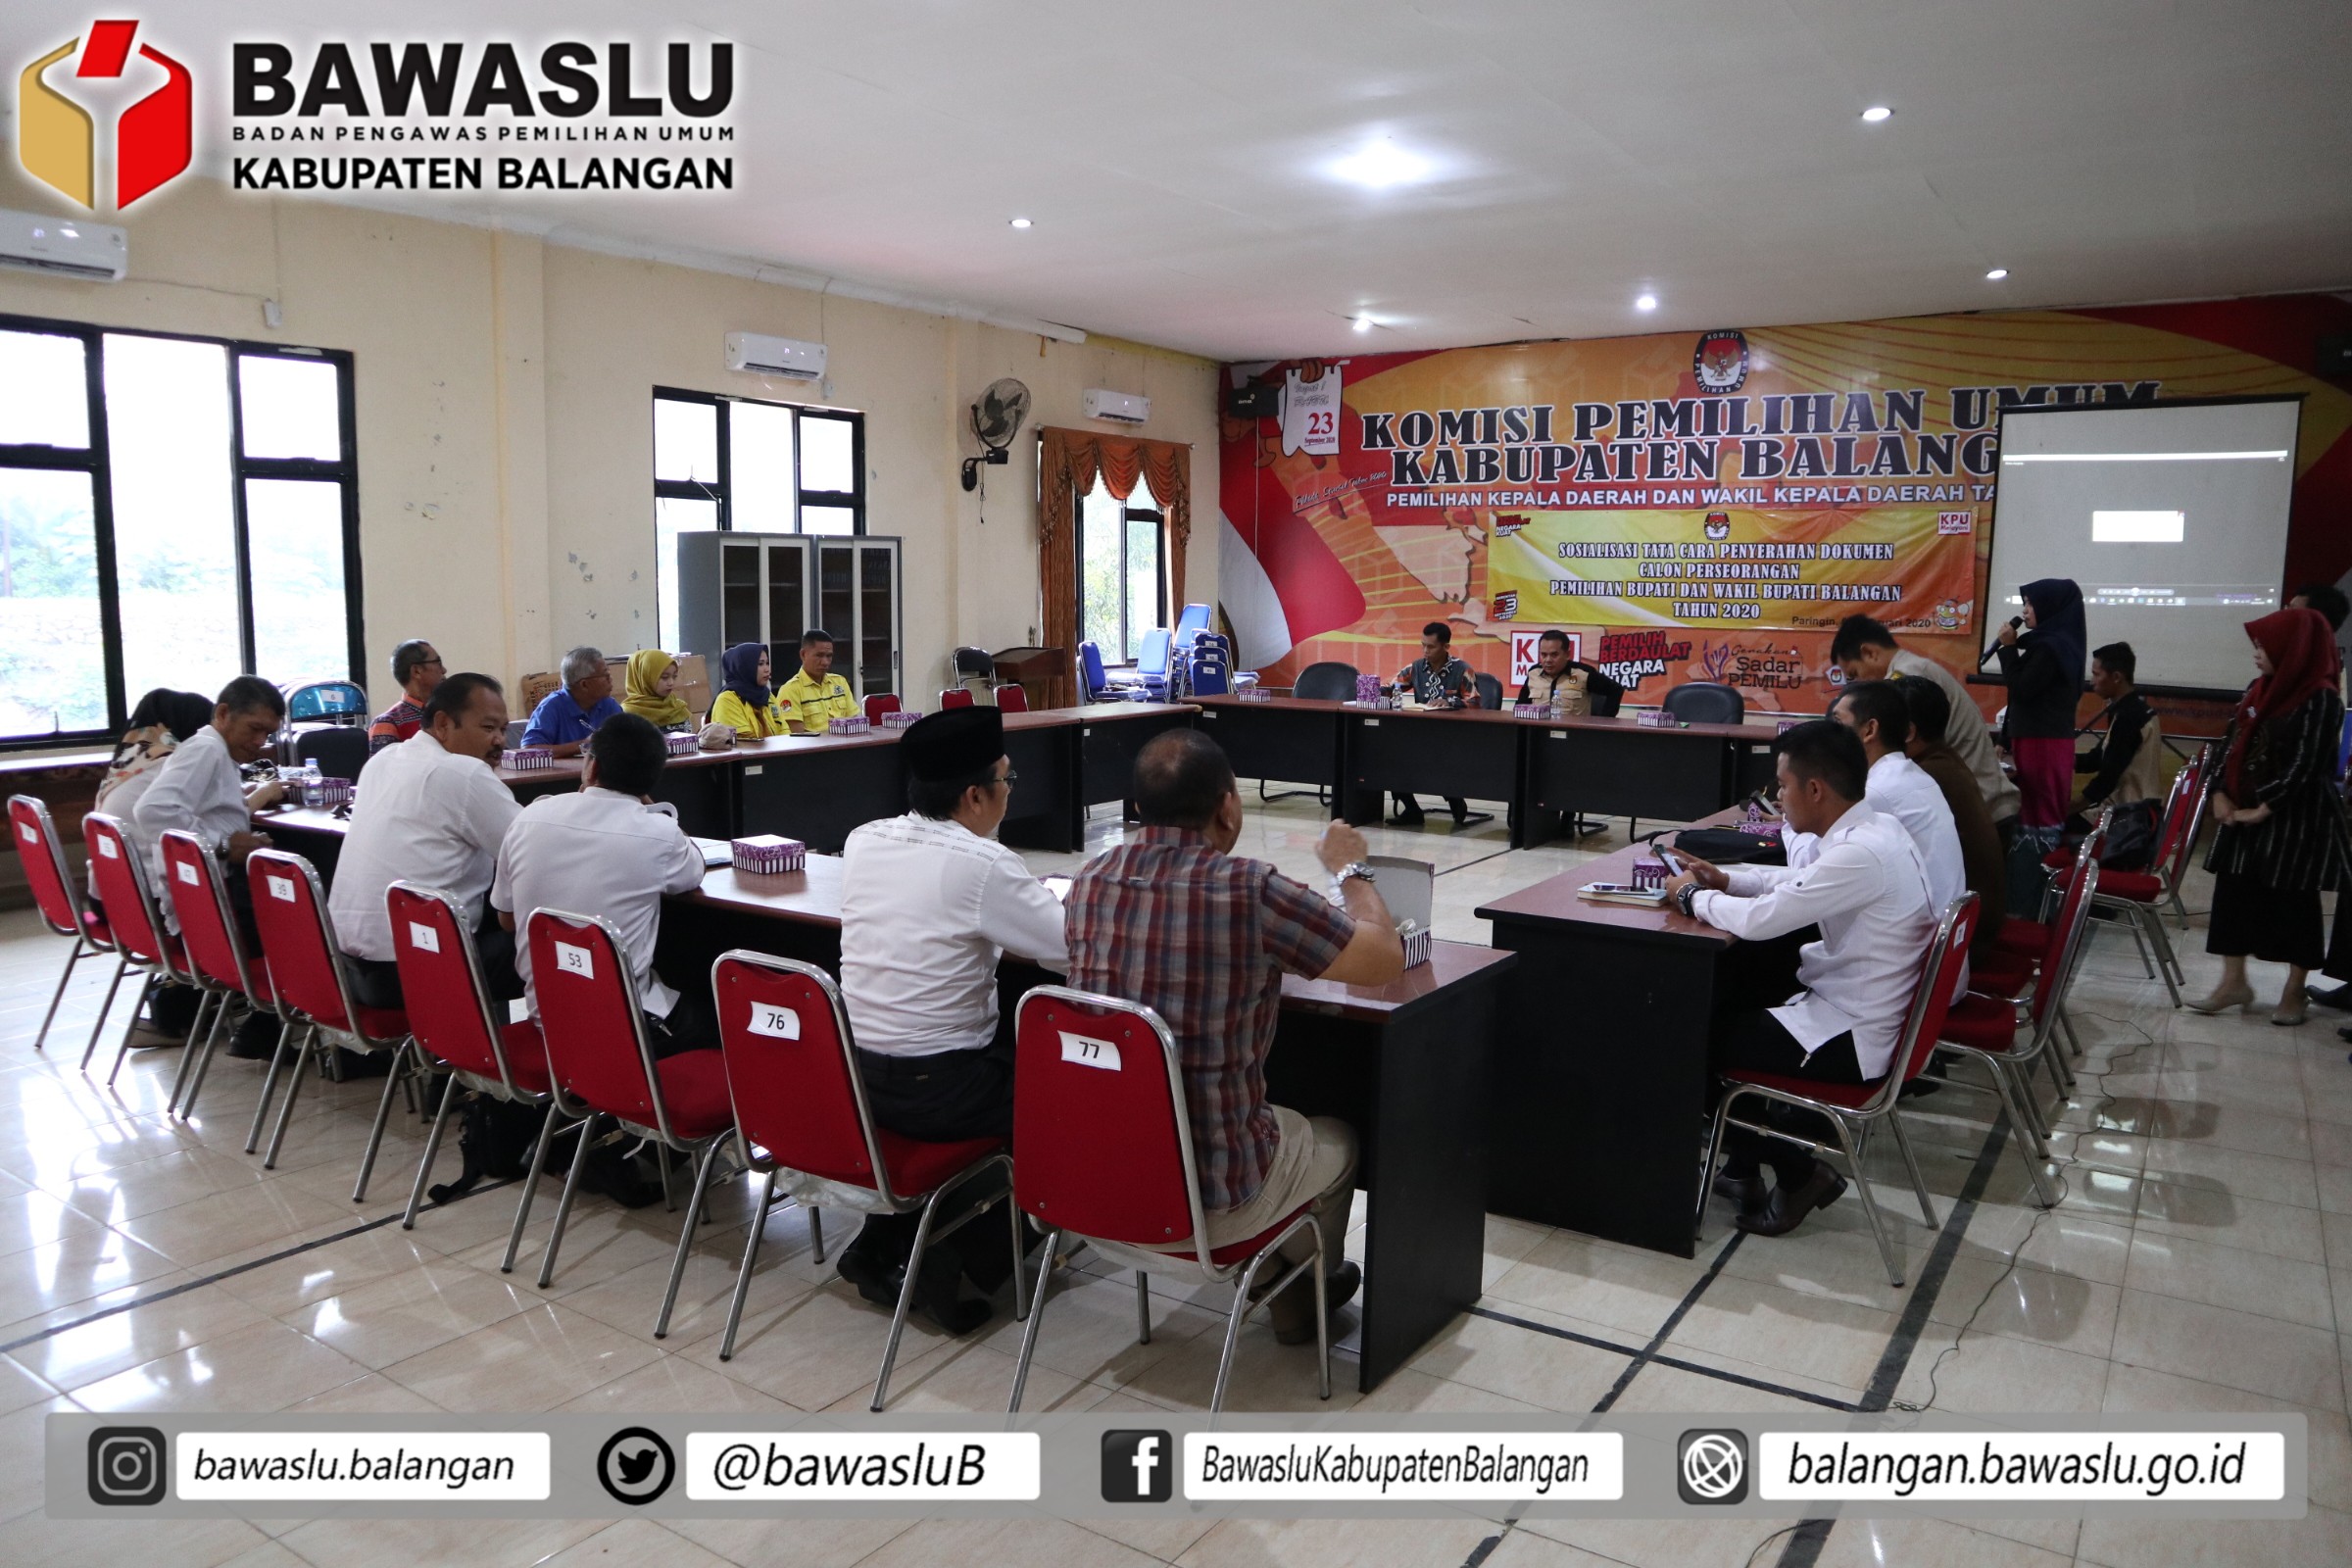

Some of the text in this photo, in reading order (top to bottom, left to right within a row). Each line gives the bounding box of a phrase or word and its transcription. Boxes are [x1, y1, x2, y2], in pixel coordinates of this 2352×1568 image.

[1707, 331, 1739, 340] KOMISI
[1307, 412, 1334, 435] 23
[1361, 404, 1554, 450] KOMISI
[1572, 389, 1926, 443] PEMILIHAN
[1391, 431, 1997, 486] KABUPATEN BALANG
[1387, 490, 1482, 507] PEMILIHAN
[1488, 490, 1560, 507] KEPALA
[1566, 489, 1646, 506] DAERAH
[1653, 488, 1695, 505] DAN
[1700, 487, 1768, 505] WAKIL
[1774, 485, 1861, 504] KEPALA
[1867, 484, 1963, 503] DAERAH
[1940, 514, 1969, 524] KPU
[1559, 542, 1893, 560] SOSIALISASI TATA CARA PENYERAHAN DOKUMEN
[1639, 562, 1799, 579] CALON PERSEORANGAN
[1549, 579, 1901, 602] PEMILIHAN BUPATI DAN WAKIL BUPATI BALANGAN
[1494, 598, 1517, 614] 23
[1673, 602, 1761, 619] TAHUN 2020
[1906, 618, 1931, 628] 2020
[1600, 630, 1666, 651] PEMILIH
[1599, 642, 1691, 663] BERDAULAT
[1731, 642, 1789, 657] Gerakan
[1598, 659, 1665, 676] NEGARA
[1736, 657, 1801, 673] Sadar
[1728, 672, 1802, 689] PEMILU
[421, 931, 429, 945] 1
[567, 952, 582, 968] 53
[767, 1012, 785, 1030] 76
[1078, 1041, 1100, 1058] 77
